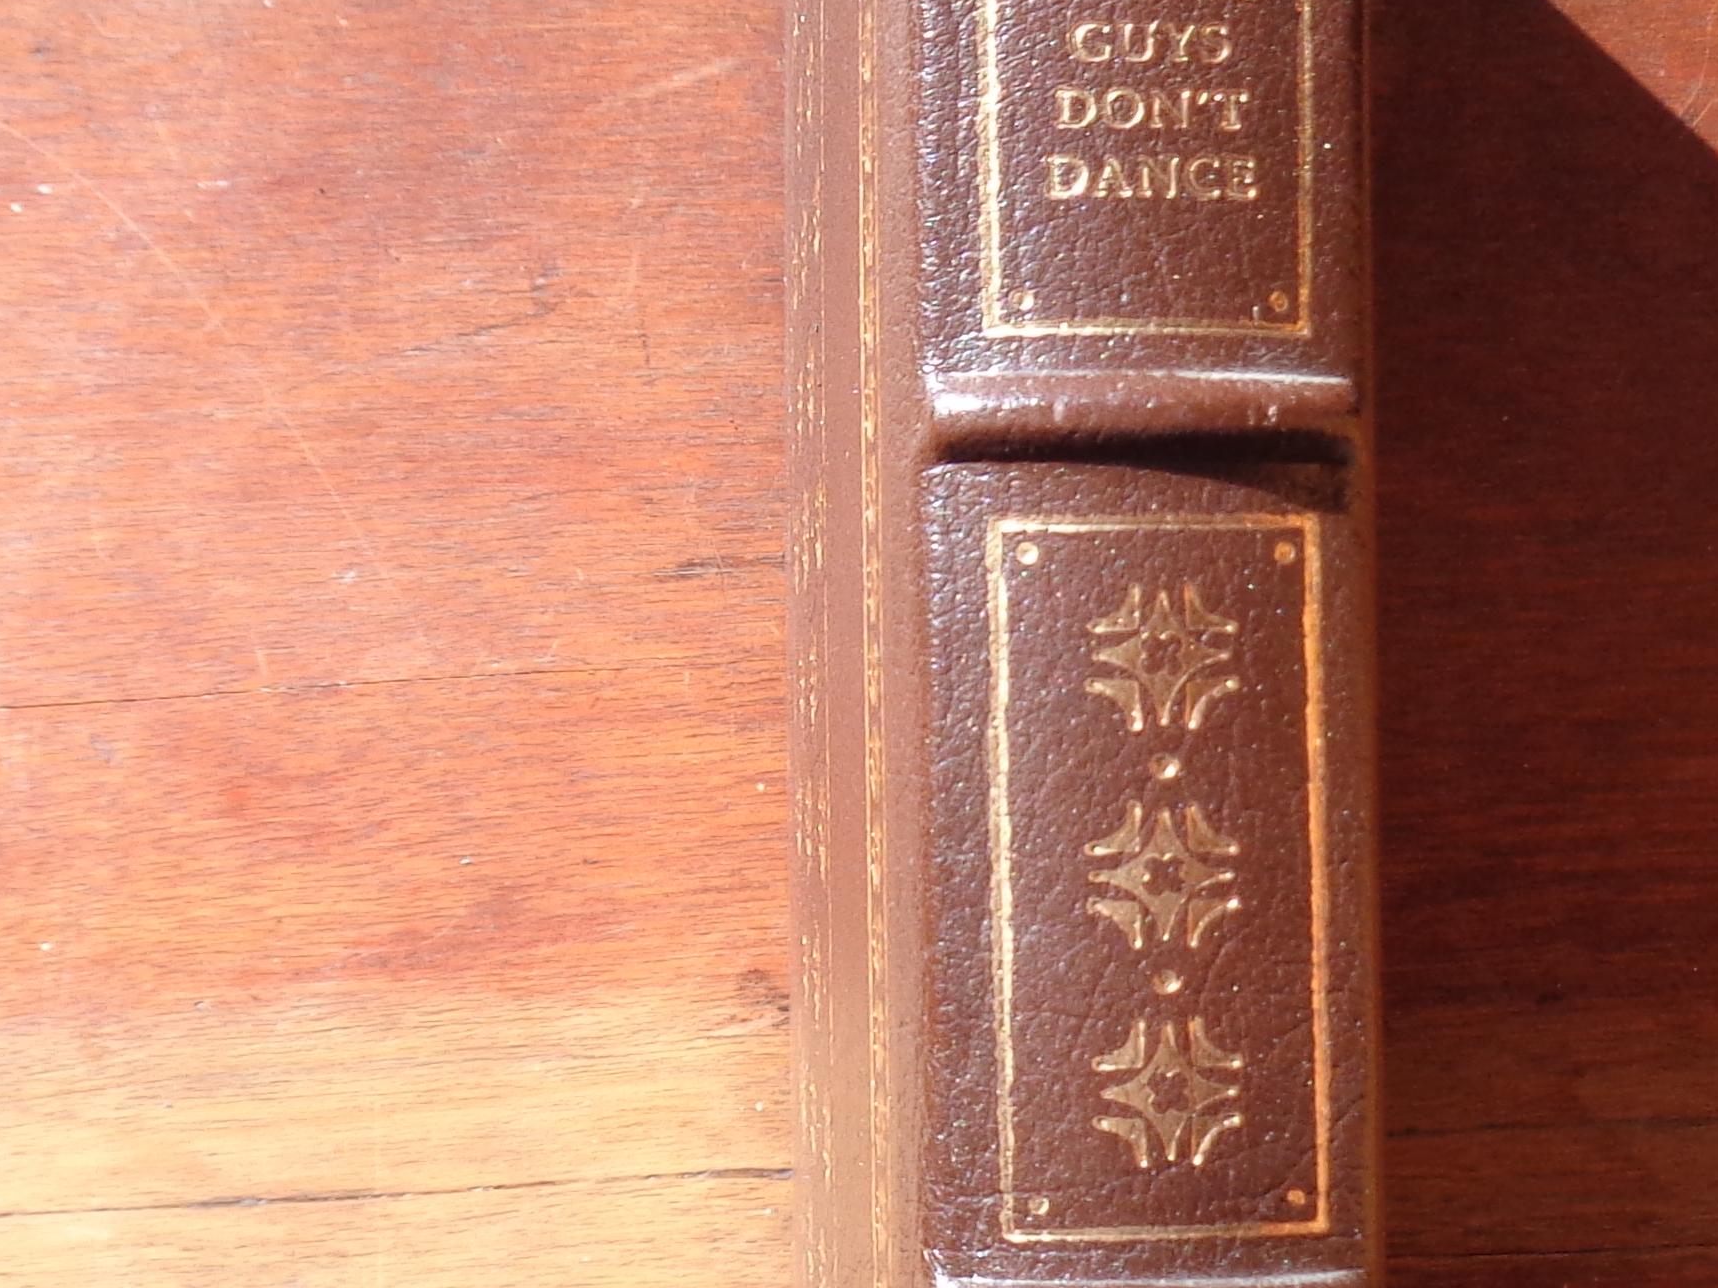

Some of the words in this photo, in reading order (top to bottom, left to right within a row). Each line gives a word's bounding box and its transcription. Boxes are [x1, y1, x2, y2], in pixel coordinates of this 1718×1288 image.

[1072, 20, 1233, 63] GUYS
[1055, 86, 1250, 130] DON'T
[1045, 154, 1258, 201] DANCE
